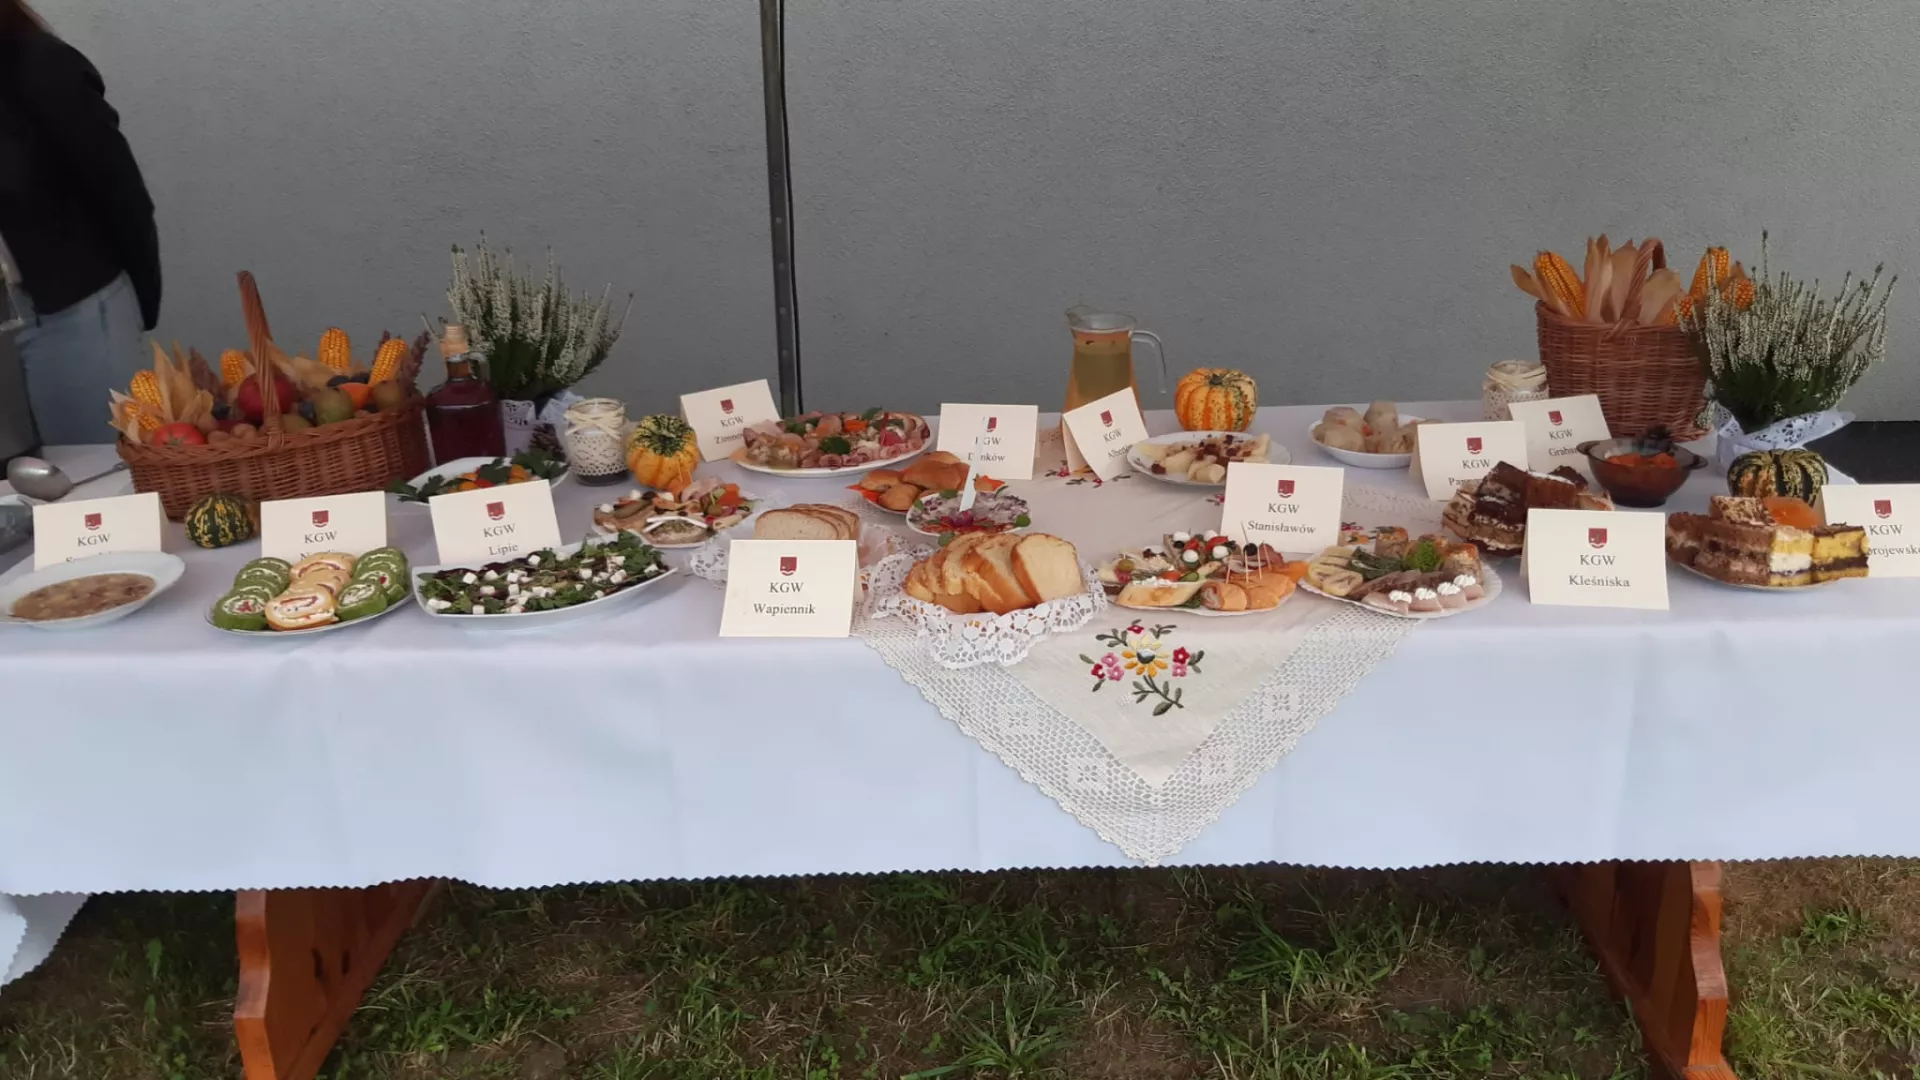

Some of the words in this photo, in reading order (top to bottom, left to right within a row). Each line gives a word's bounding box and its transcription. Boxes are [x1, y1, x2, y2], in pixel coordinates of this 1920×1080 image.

[720, 416, 744, 427] KGW
[1103, 428, 1121, 442] KGW
[1548, 429, 1573, 440] KGW
[1462, 459, 1490, 469] KGW
[1268, 503, 1300, 514] KGW
[483, 523, 516, 538] KGW
[1247, 520, 1316, 534] Stanisławów
[1868, 524, 1904, 536] KGW
[77, 533, 111, 547] KGW
[304, 530, 338, 544] KGW
[488, 542, 519, 555] Lipie
[1579, 554, 1616, 566] KGW
[769, 581, 804, 593] KGW
[1569, 574, 1630, 587] Kleśniska
[754, 602, 816, 616] Wapiennik
